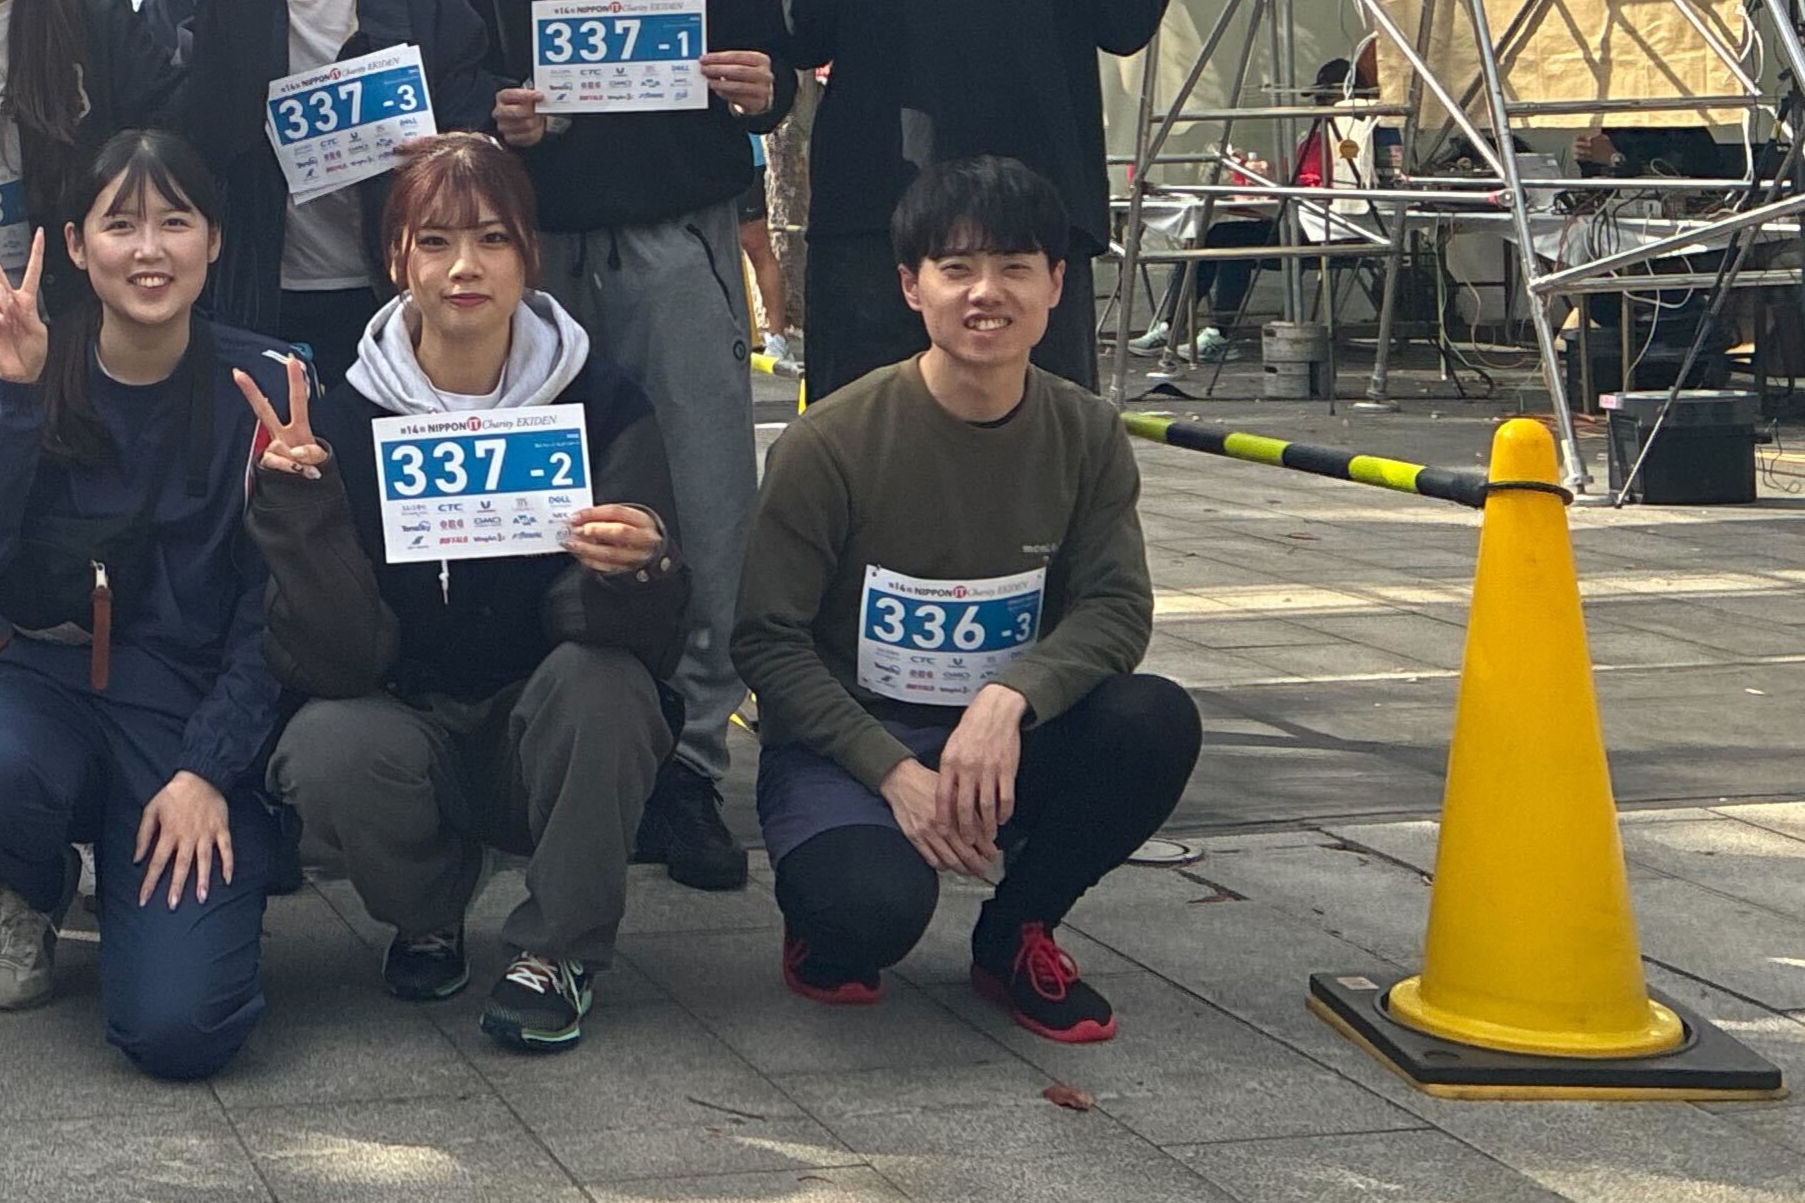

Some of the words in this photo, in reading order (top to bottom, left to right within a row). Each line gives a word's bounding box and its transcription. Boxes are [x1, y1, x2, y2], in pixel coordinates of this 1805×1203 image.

[545, 19, 641, 62] 337
[658, 31, 689, 57] -1
[278, 81, 362, 139] 337
[383, 85, 417, 111] -3
[427, 422, 467, 433] NIPPON
[482, 420, 514, 430] Charity
[516, 415, 557, 427] EKIDEN
[391, 438, 506, 495] 337
[530, 452, 573, 486] -2
[438, 503, 462, 512] CTC
[914, 587, 952, 597] NIPPON
[873, 597, 986, 650] 336
[1001, 612, 1032, 641] -3
